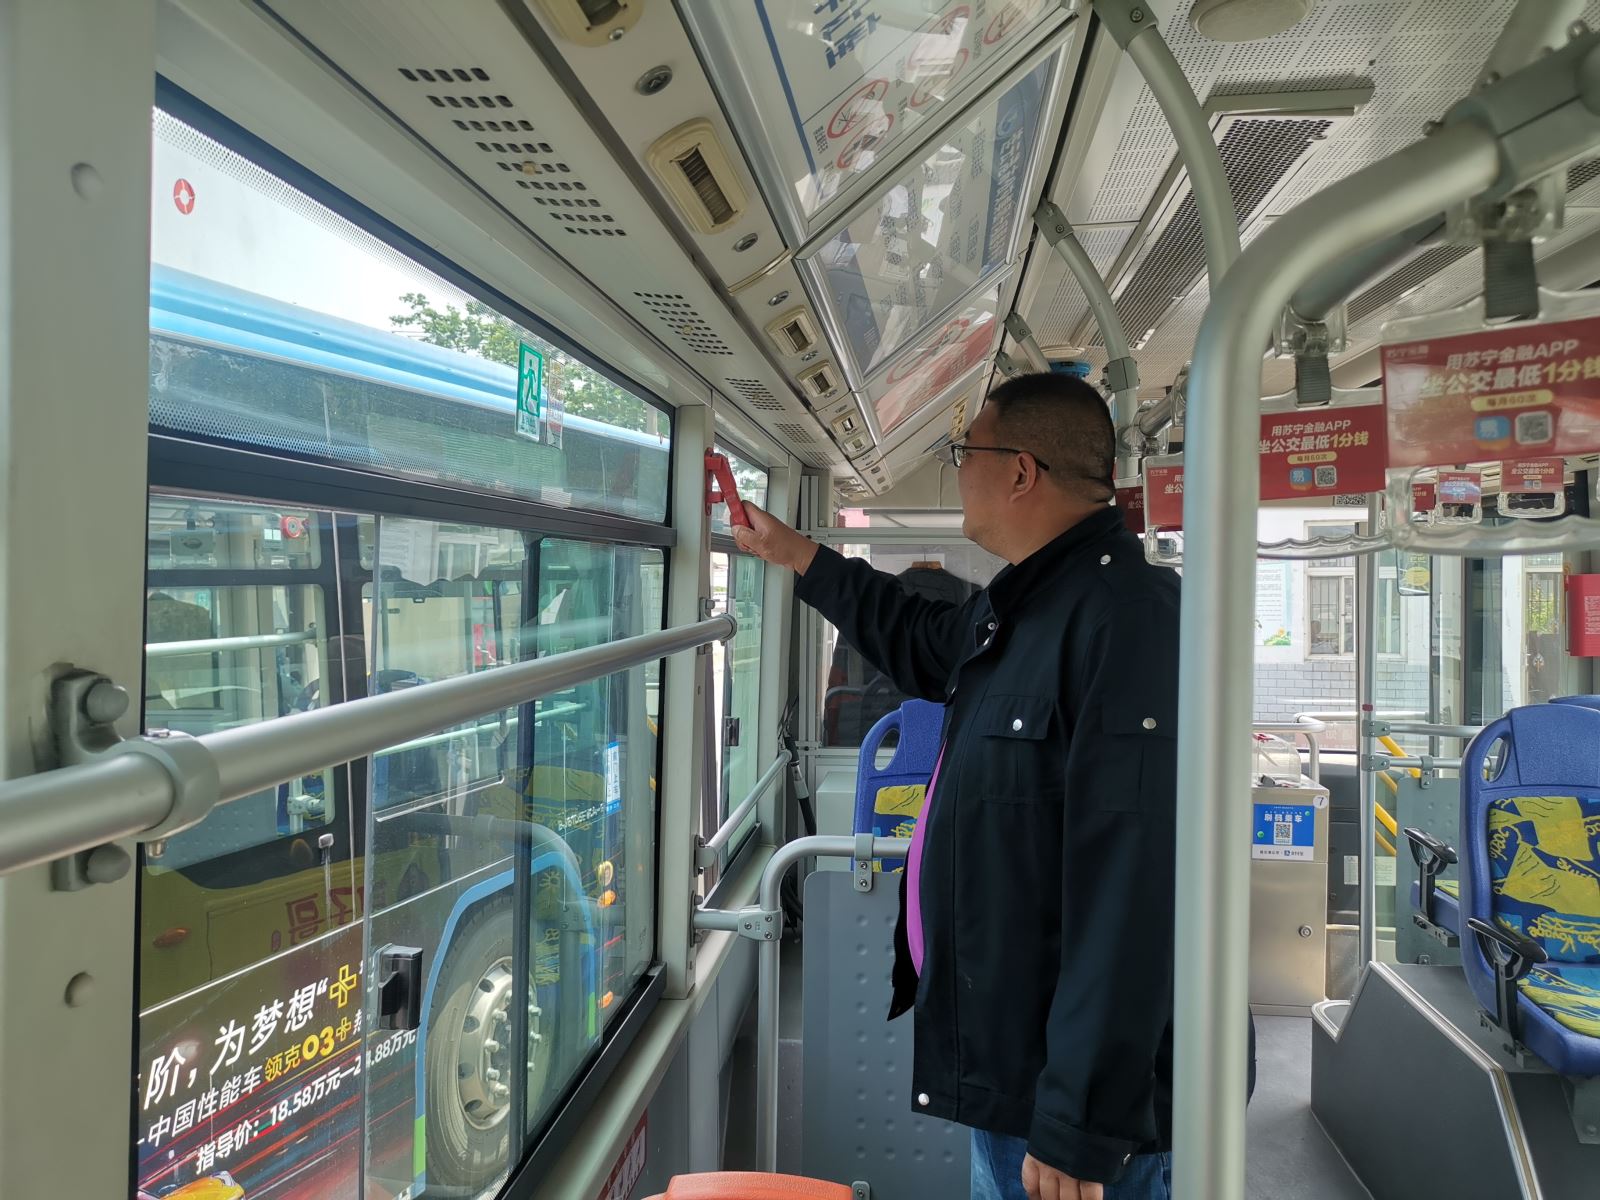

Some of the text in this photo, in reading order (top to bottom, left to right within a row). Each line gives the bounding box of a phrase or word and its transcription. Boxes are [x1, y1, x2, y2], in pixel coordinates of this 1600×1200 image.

[1446, 339, 1580, 370] 用苏宁金融APP
[1271, 419, 1352, 437] 用苏宁金融APP
[1258, 430, 1369, 454] 坐公交最低1分钱
